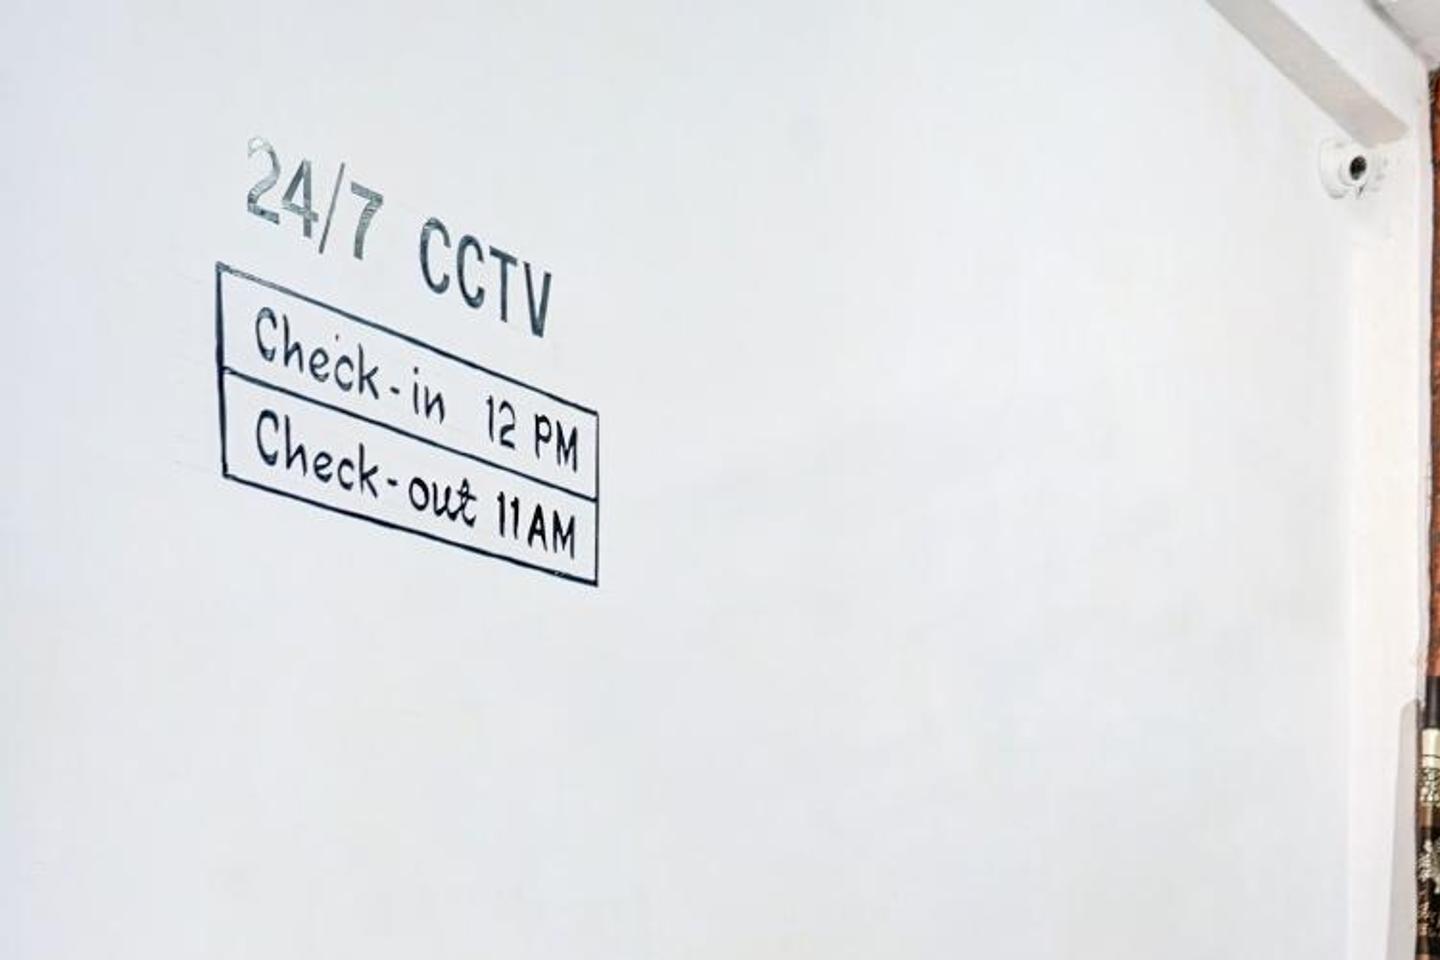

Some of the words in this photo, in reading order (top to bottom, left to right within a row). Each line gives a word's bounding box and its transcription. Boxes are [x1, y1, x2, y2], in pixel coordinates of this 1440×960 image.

[246, 136, 384, 260] 24/7
[418, 217, 552, 338] CCTV
[255, 306, 447, 424] Check-in
[486, 396, 517, 450] 12
[534, 413, 579, 472] PM
[255, 409, 478, 528] Check-out
